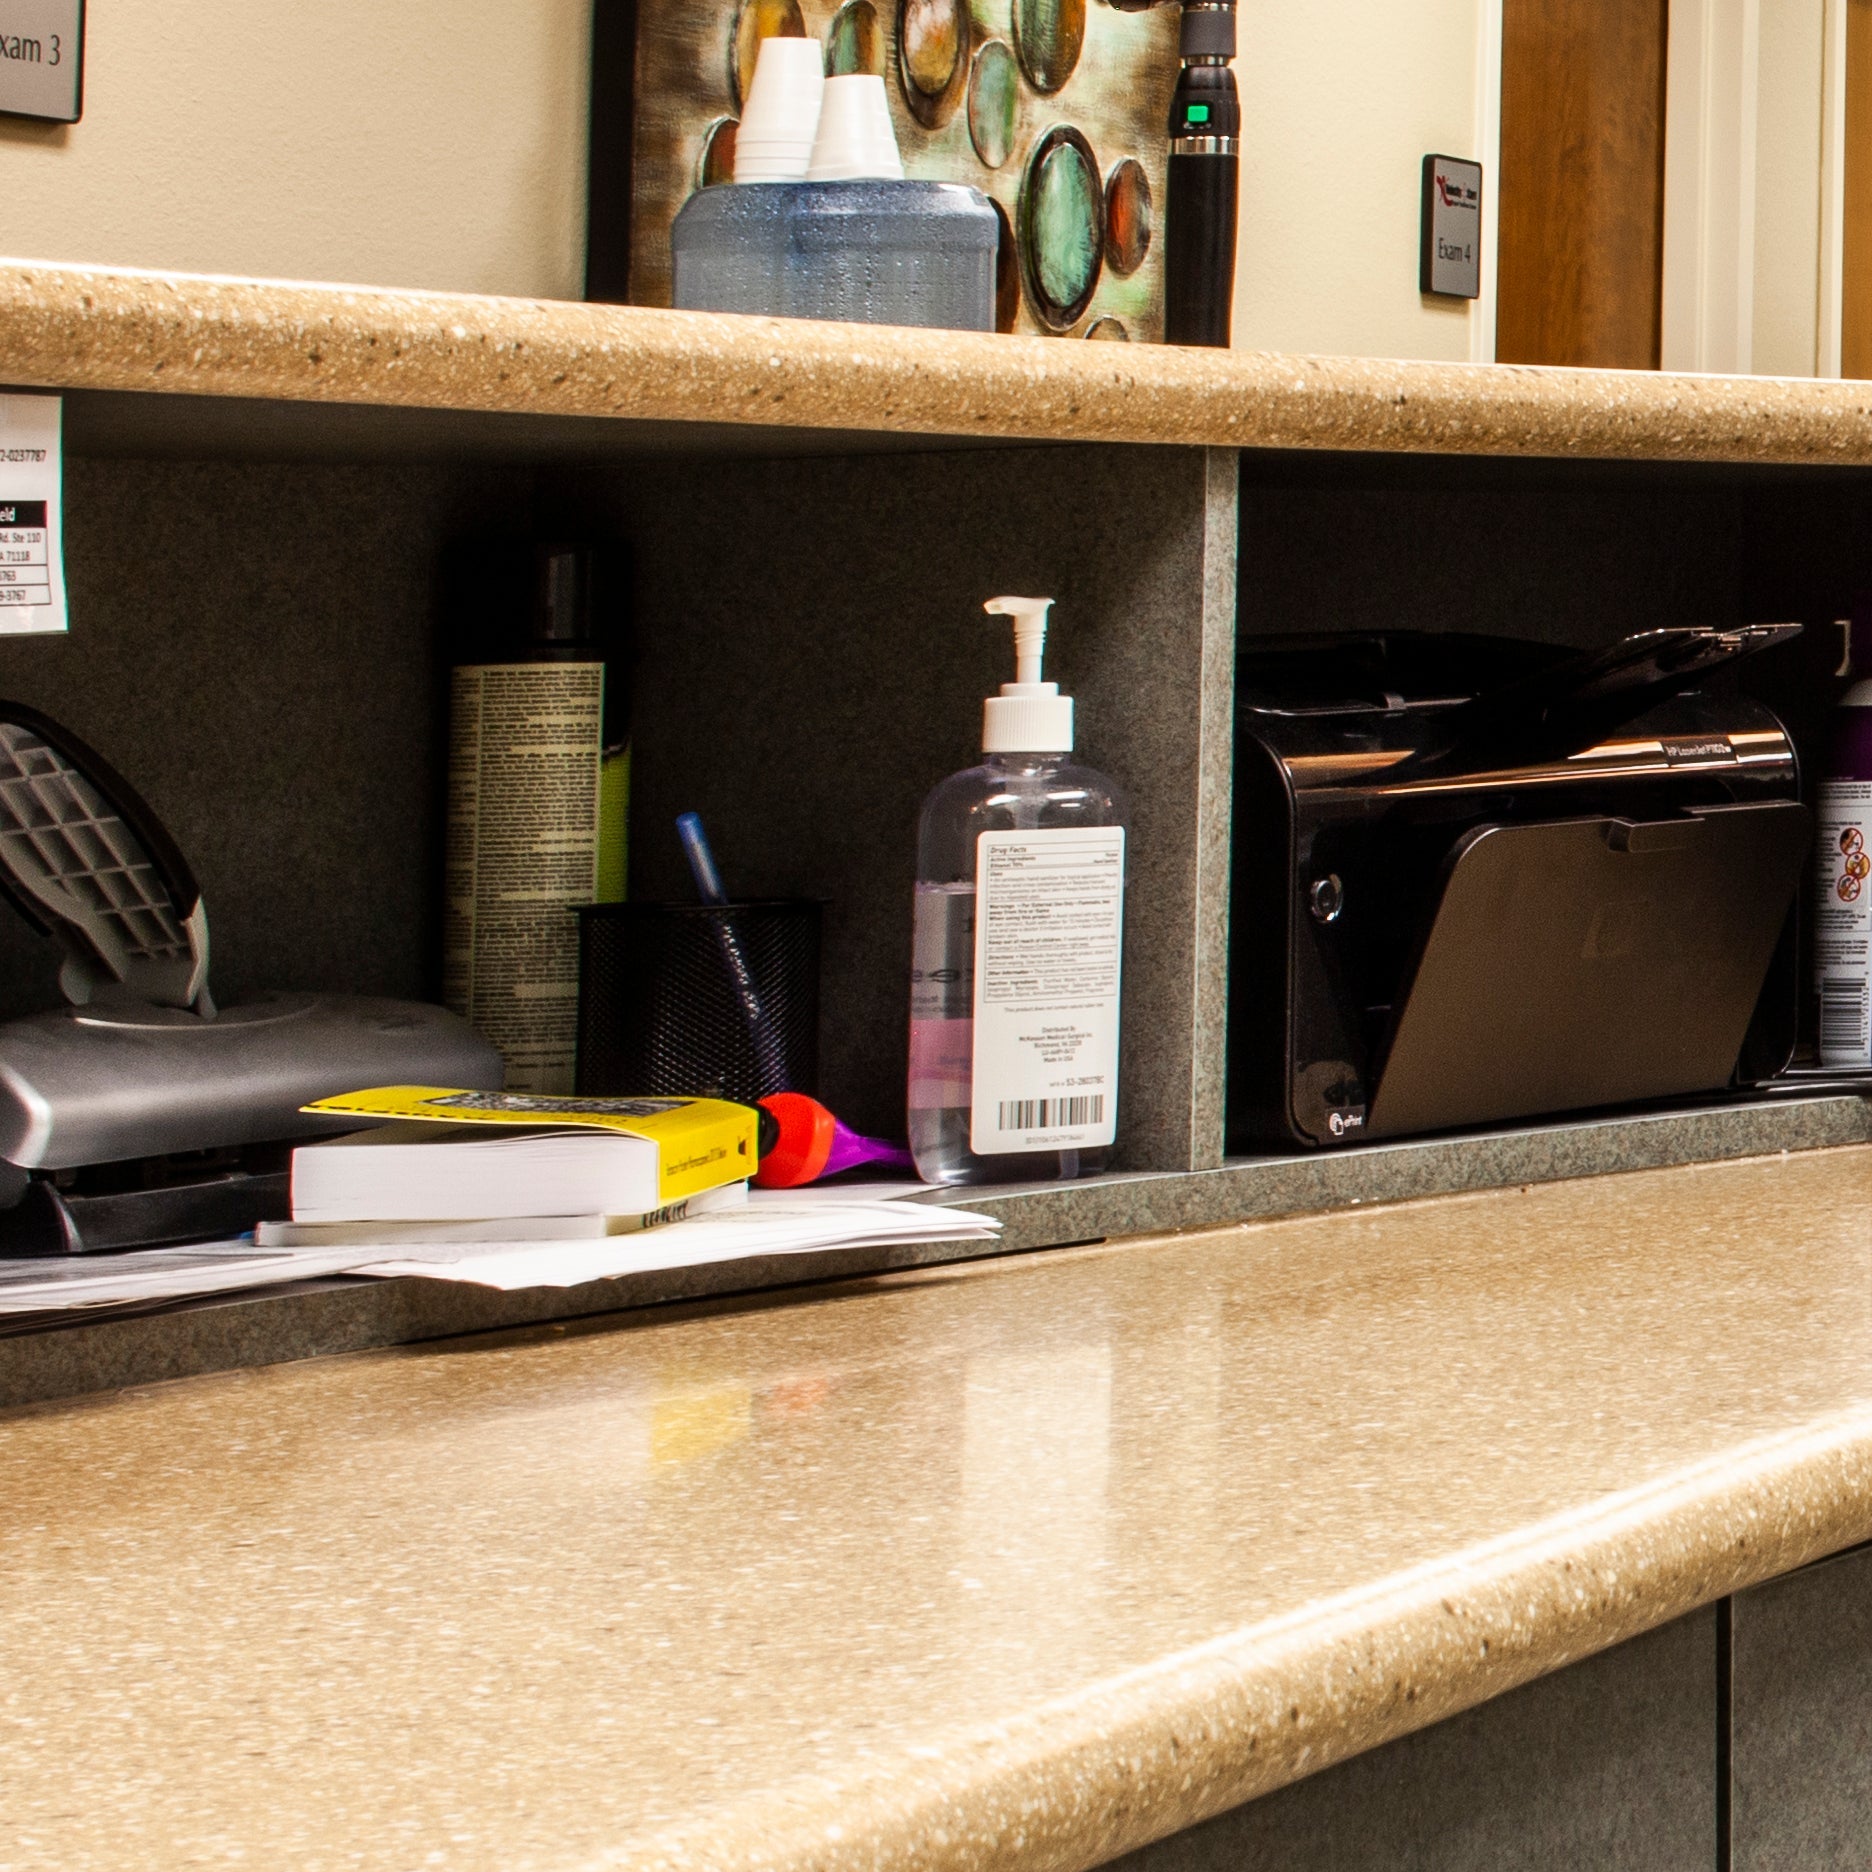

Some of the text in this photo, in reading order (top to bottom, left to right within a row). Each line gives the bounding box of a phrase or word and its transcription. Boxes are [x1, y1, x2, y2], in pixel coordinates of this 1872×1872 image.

[48, 35, 60, 66] 3
[1438, 237, 1463, 262] Exam
[990, 846, 1007, 855] Drug
